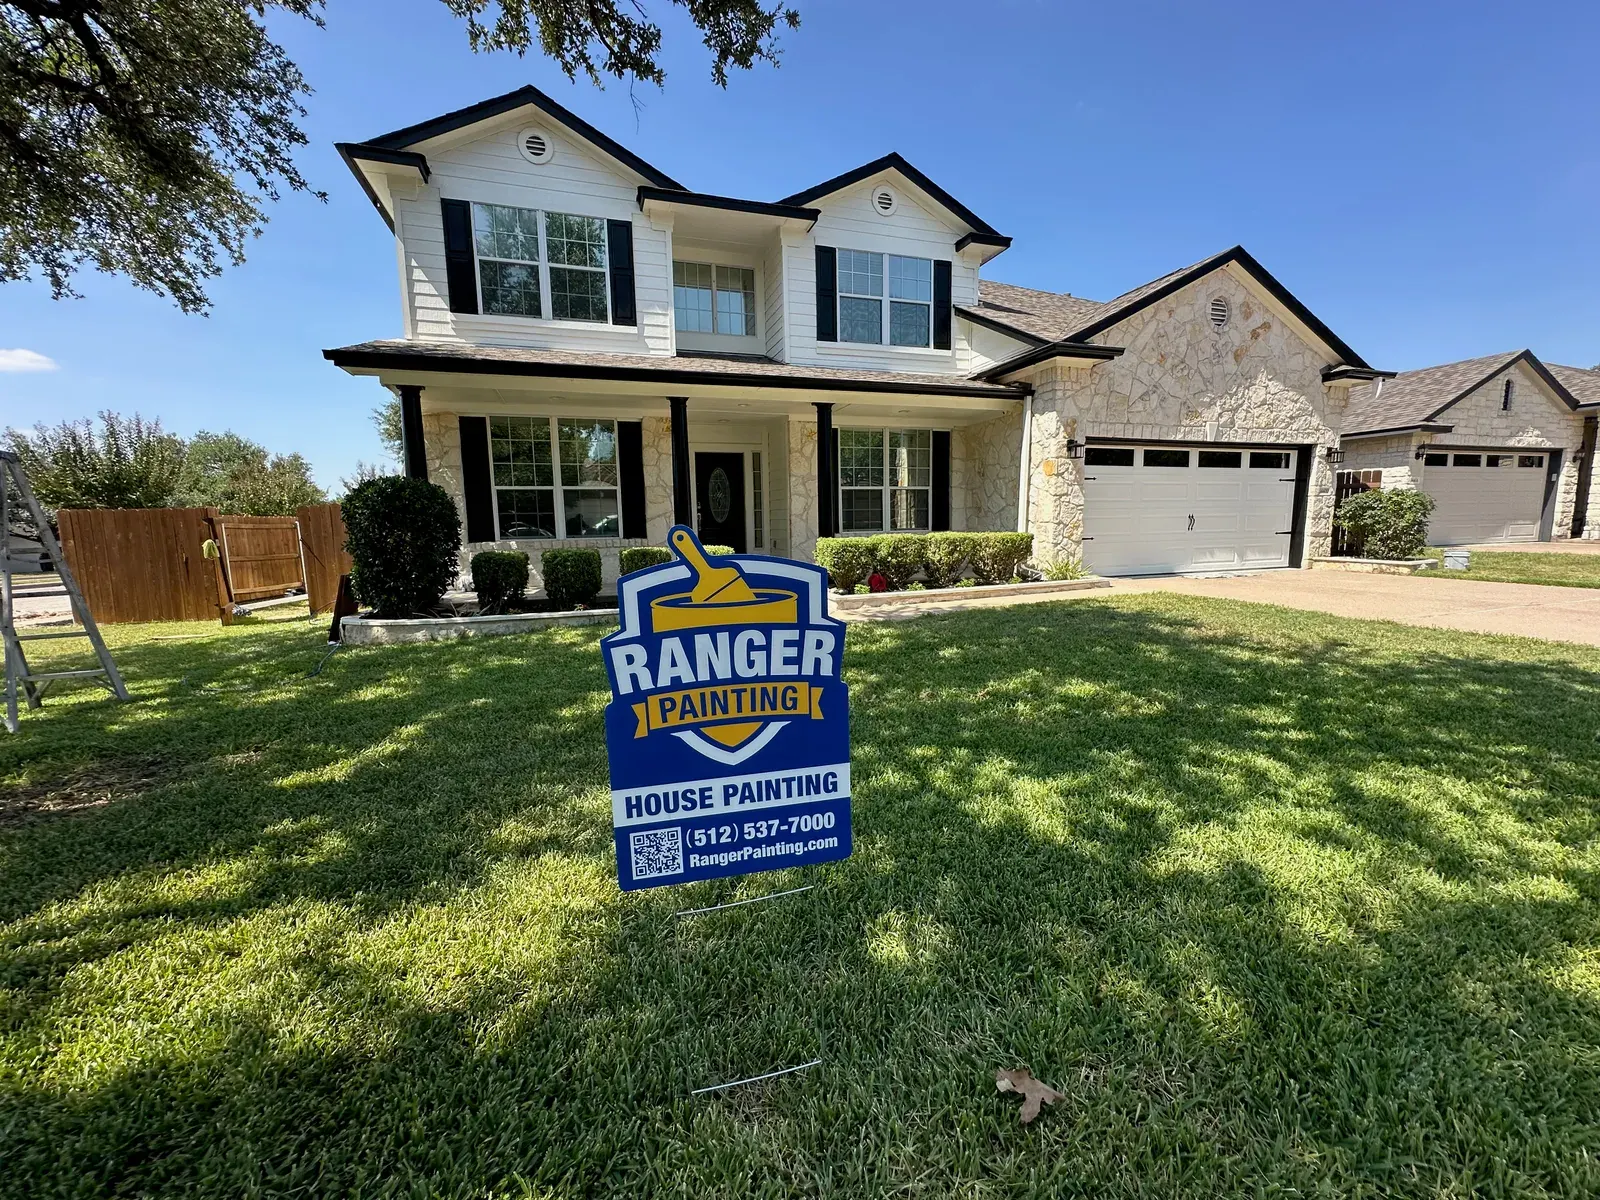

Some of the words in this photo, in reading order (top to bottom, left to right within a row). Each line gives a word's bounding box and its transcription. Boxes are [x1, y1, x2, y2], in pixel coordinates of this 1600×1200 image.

[610, 629, 836, 695] RANGER
[659, 685, 798, 723] PAINTING
[625, 787, 713, 819] HOUSE
[723, 771, 838, 806] PAINTING
[685, 823, 739, 848] (512)
[743, 811, 835, 839] 537-7000
[689, 836, 838, 868] RangerPainting.com
